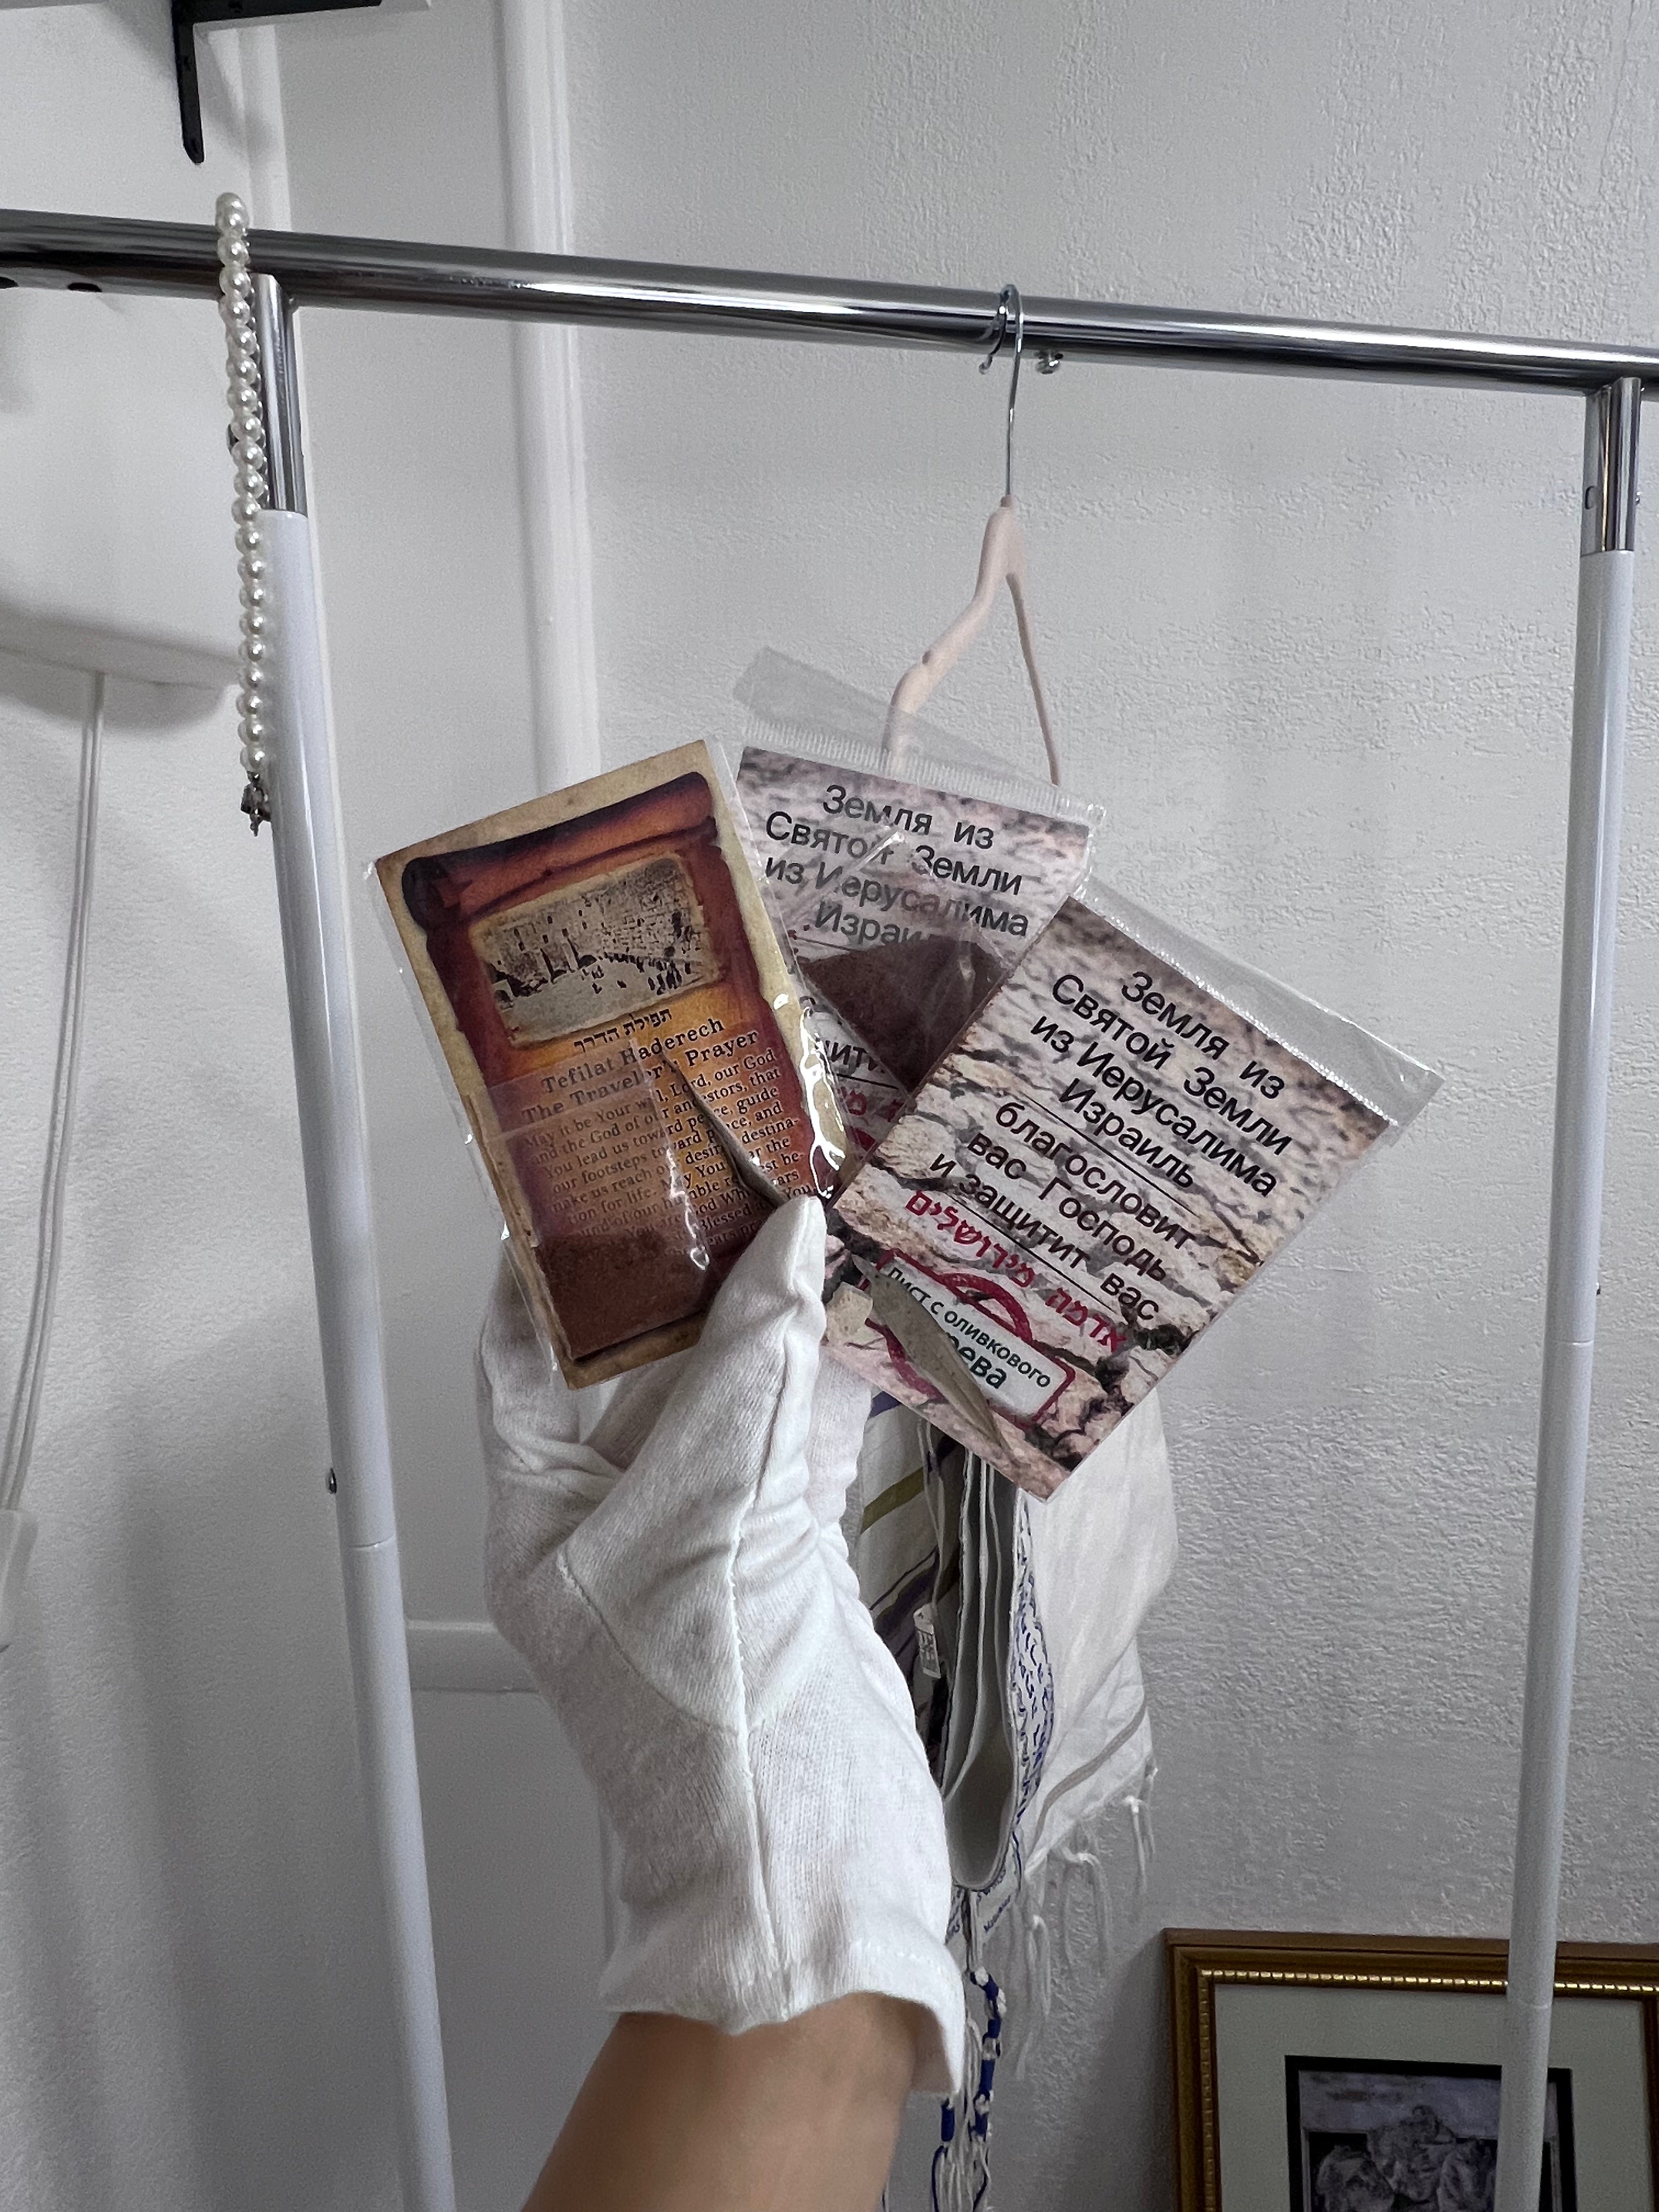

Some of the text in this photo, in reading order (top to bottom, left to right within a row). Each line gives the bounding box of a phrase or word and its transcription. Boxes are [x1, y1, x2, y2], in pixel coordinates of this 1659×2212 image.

[823, 785, 994, 849] Земля из
[765, 857, 808, 887] из
[911, 845, 1024, 896] Земли
[815, 904, 923, 945] Израи
[541, 1017, 723, 1092] Tefilat Haderech
[574, 1029, 619, 1054] הדרך
[1052, 974, 1293, 1155] Святой Земли
[1121, 971, 1285, 1099] Земля из
[522, 1031, 758, 1123] The Travelr' Prayer
[589, 1124, 619, 1143] God
[674, 1082, 746, 1114] ancstors,
[749, 1066, 779, 1086] that
[636, 1089, 668, 1109] wl,
[714, 1065, 740, 1081] our
[743, 1050, 774, 1070] God
[687, 1105, 732, 1131] pee,
[736, 1086, 780, 1114] guide
[1030, 1015, 1277, 1197] из Иерусалима
[685, 1143, 722, 1164] desir
[742, 1115, 799, 1143] destina-
[706, 1116, 752, 1142] pce,
[754, 1103, 781, 1120] and
[1058, 1077, 1194, 1194] Израиль
[661, 1173, 693, 1189] My
[696, 1159, 724, 1177] You
[766, 1136, 789, 1152] the
[995, 1102, 1197, 1250] благословит
[695, 1198, 715, 1214] od
[721, 1186, 749, 1205] Wh
[966, 1132, 1167, 1286] вас Господь
[905, 1189, 1127, 1352] אדמה מירושלים
[929, 1153, 1160, 1321] и защитит вас
[930, 1299, 945, 1315] с
[944, 1310, 1051, 1389] оливкового
[948, 1335, 1008, 1390] ева
